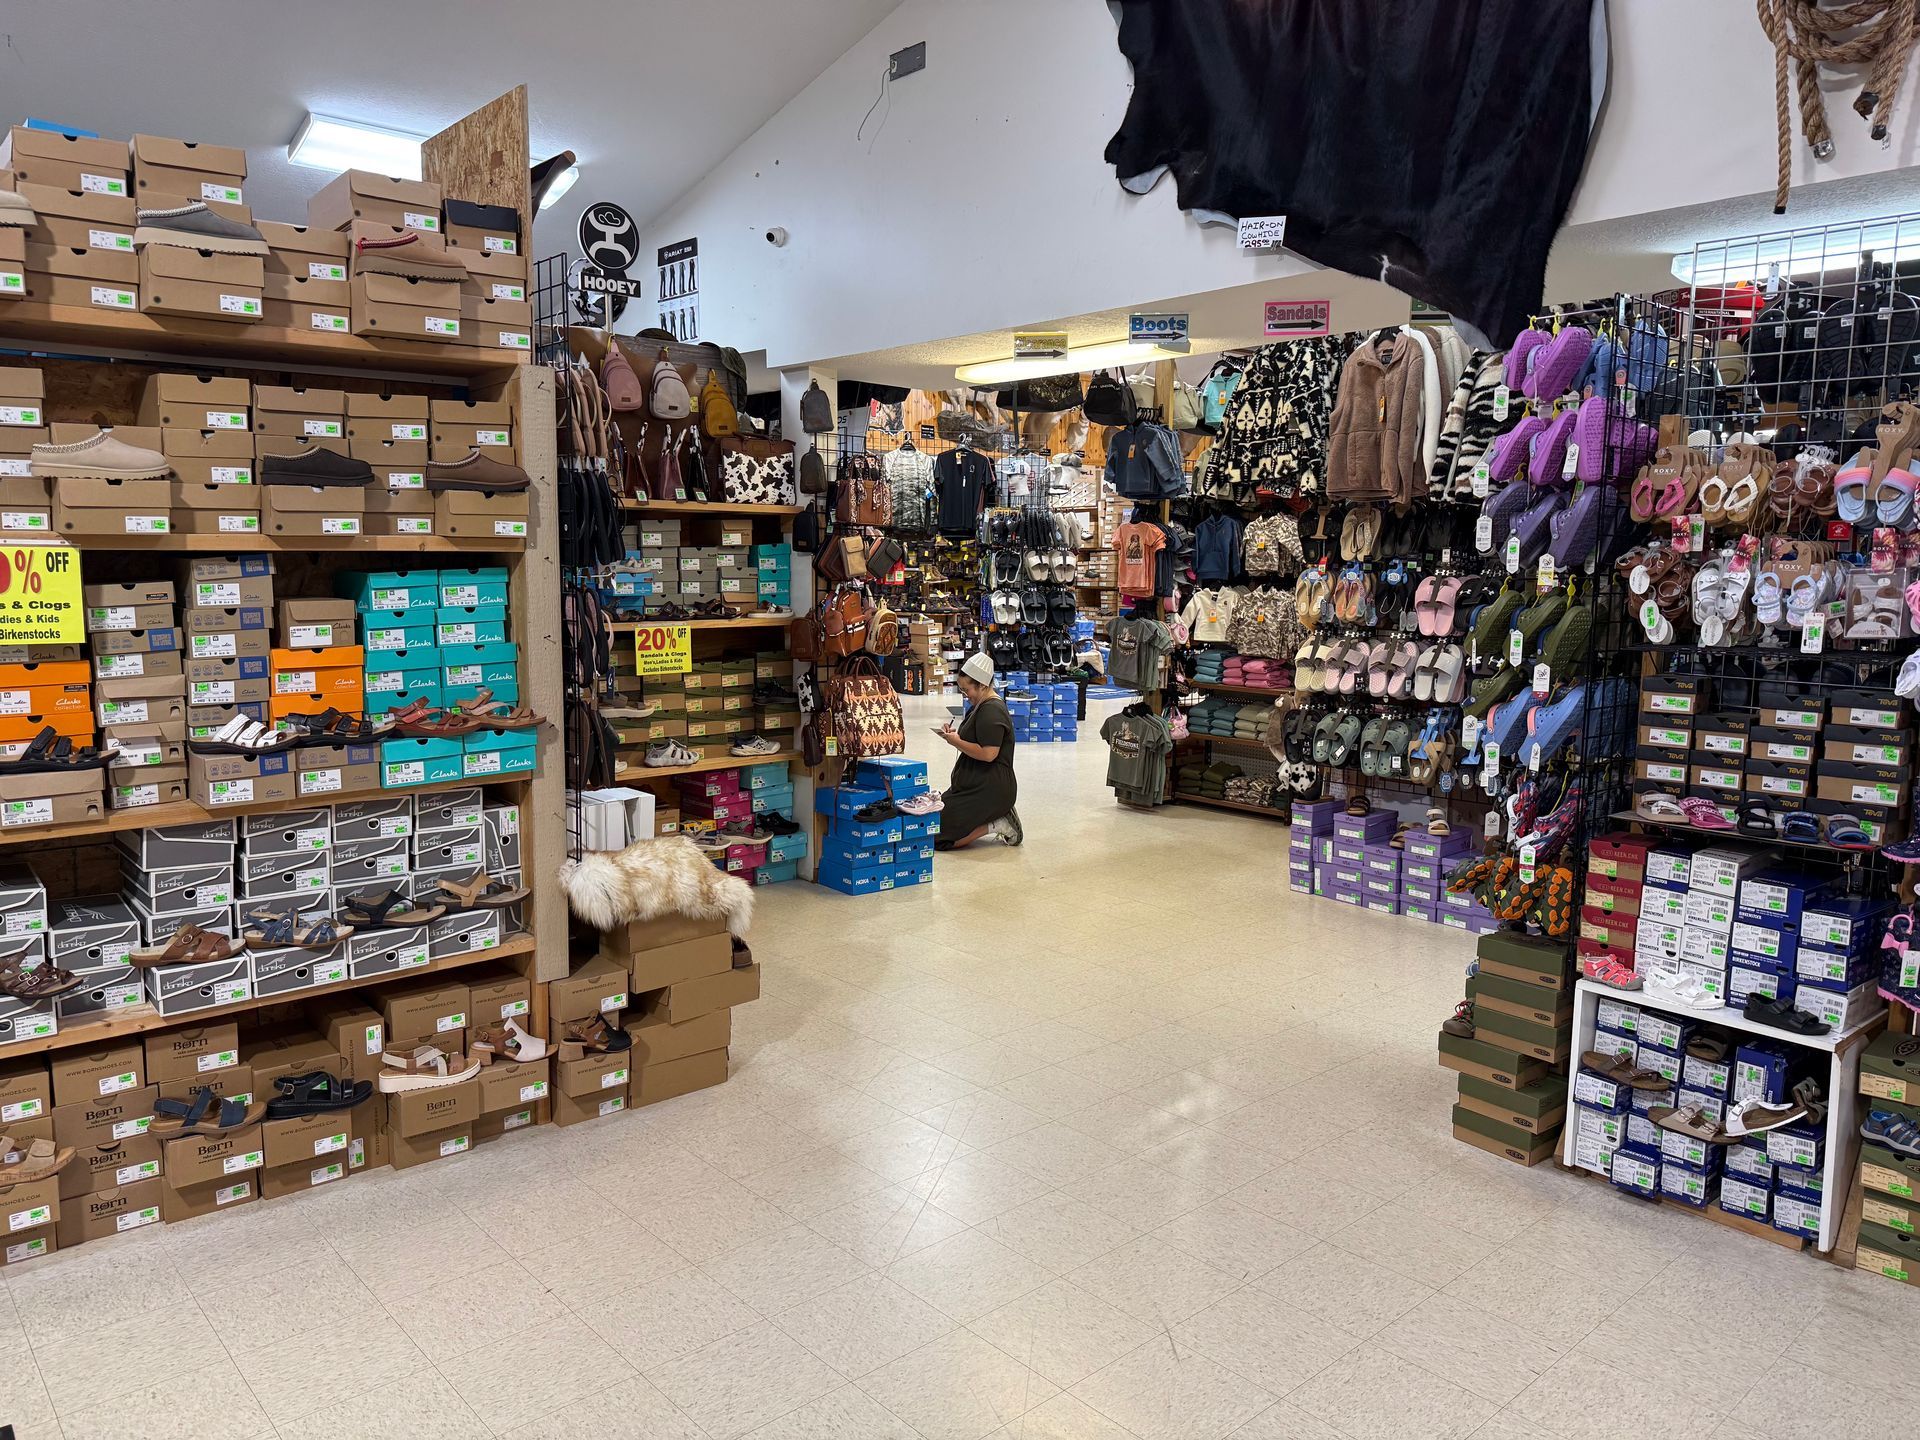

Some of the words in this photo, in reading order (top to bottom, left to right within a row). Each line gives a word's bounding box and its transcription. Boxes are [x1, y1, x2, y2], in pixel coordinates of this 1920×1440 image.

[1241, 220, 1283, 232] HAIR-ON
[1242, 230, 1280, 240] COWHIDE
[668, 248, 682, 258] ARIAT
[584, 275, 637, 295] HOOEY
[1268, 305, 1326, 321] Sandals
[1132, 316, 1186, 331] Boots
[1014, 336, 1066, 350] Clearance
[46, 552, 69, 572] OFF
[411, 599, 435, 608] Clarks
[480, 596, 504, 604] Clarks
[12, 601, 23, 609] &
[29, 601, 71, 611] Clogs
[0, 616, 21, 624] dies
[37, 615, 60, 623] Kids
[638, 628, 676, 651] 20%
[678, 628, 686, 638] OFF
[488, 673, 512, 681] Clarks
[410, 680, 436, 688] Clarks
[1676, 682, 1694, 690] Teva
[1802, 700, 1822, 708] Teva
[1726, 722, 1744, 730] Teva
[506, 760, 532, 768] Clarks
[430, 770, 458, 779] Clarks
[1788, 768, 1806, 776] Teva
[1722, 794, 1740, 802] Teva
[856, 851, 870, 859] HOKA
[158, 880, 183, 888] dansko
[856, 878, 869, 886] HOKA
[1739, 912, 1762, 920] BIRKENSTOCK
[58, 940, 86, 949] dansko
[354, 946, 380, 954] dansko
[1732, 956, 1760, 967] BIRKENSTOCK
[258, 962, 286, 972] dansko
[1539, 975, 1556, 984] KEEN
[163, 980, 194, 990] dansko
[1534, 1012, 1551, 1022] KEEN
[1534, 1047, 1550, 1056] KEEN
[66, 1060, 132, 1077] WWW.BORNSHOES.COM
[1513, 1116, 1533, 1128] KEEN
[281, 1120, 337, 1136] WWW.BORNSHOES.COM
[1506, 1148, 1525, 1160] KEEN
